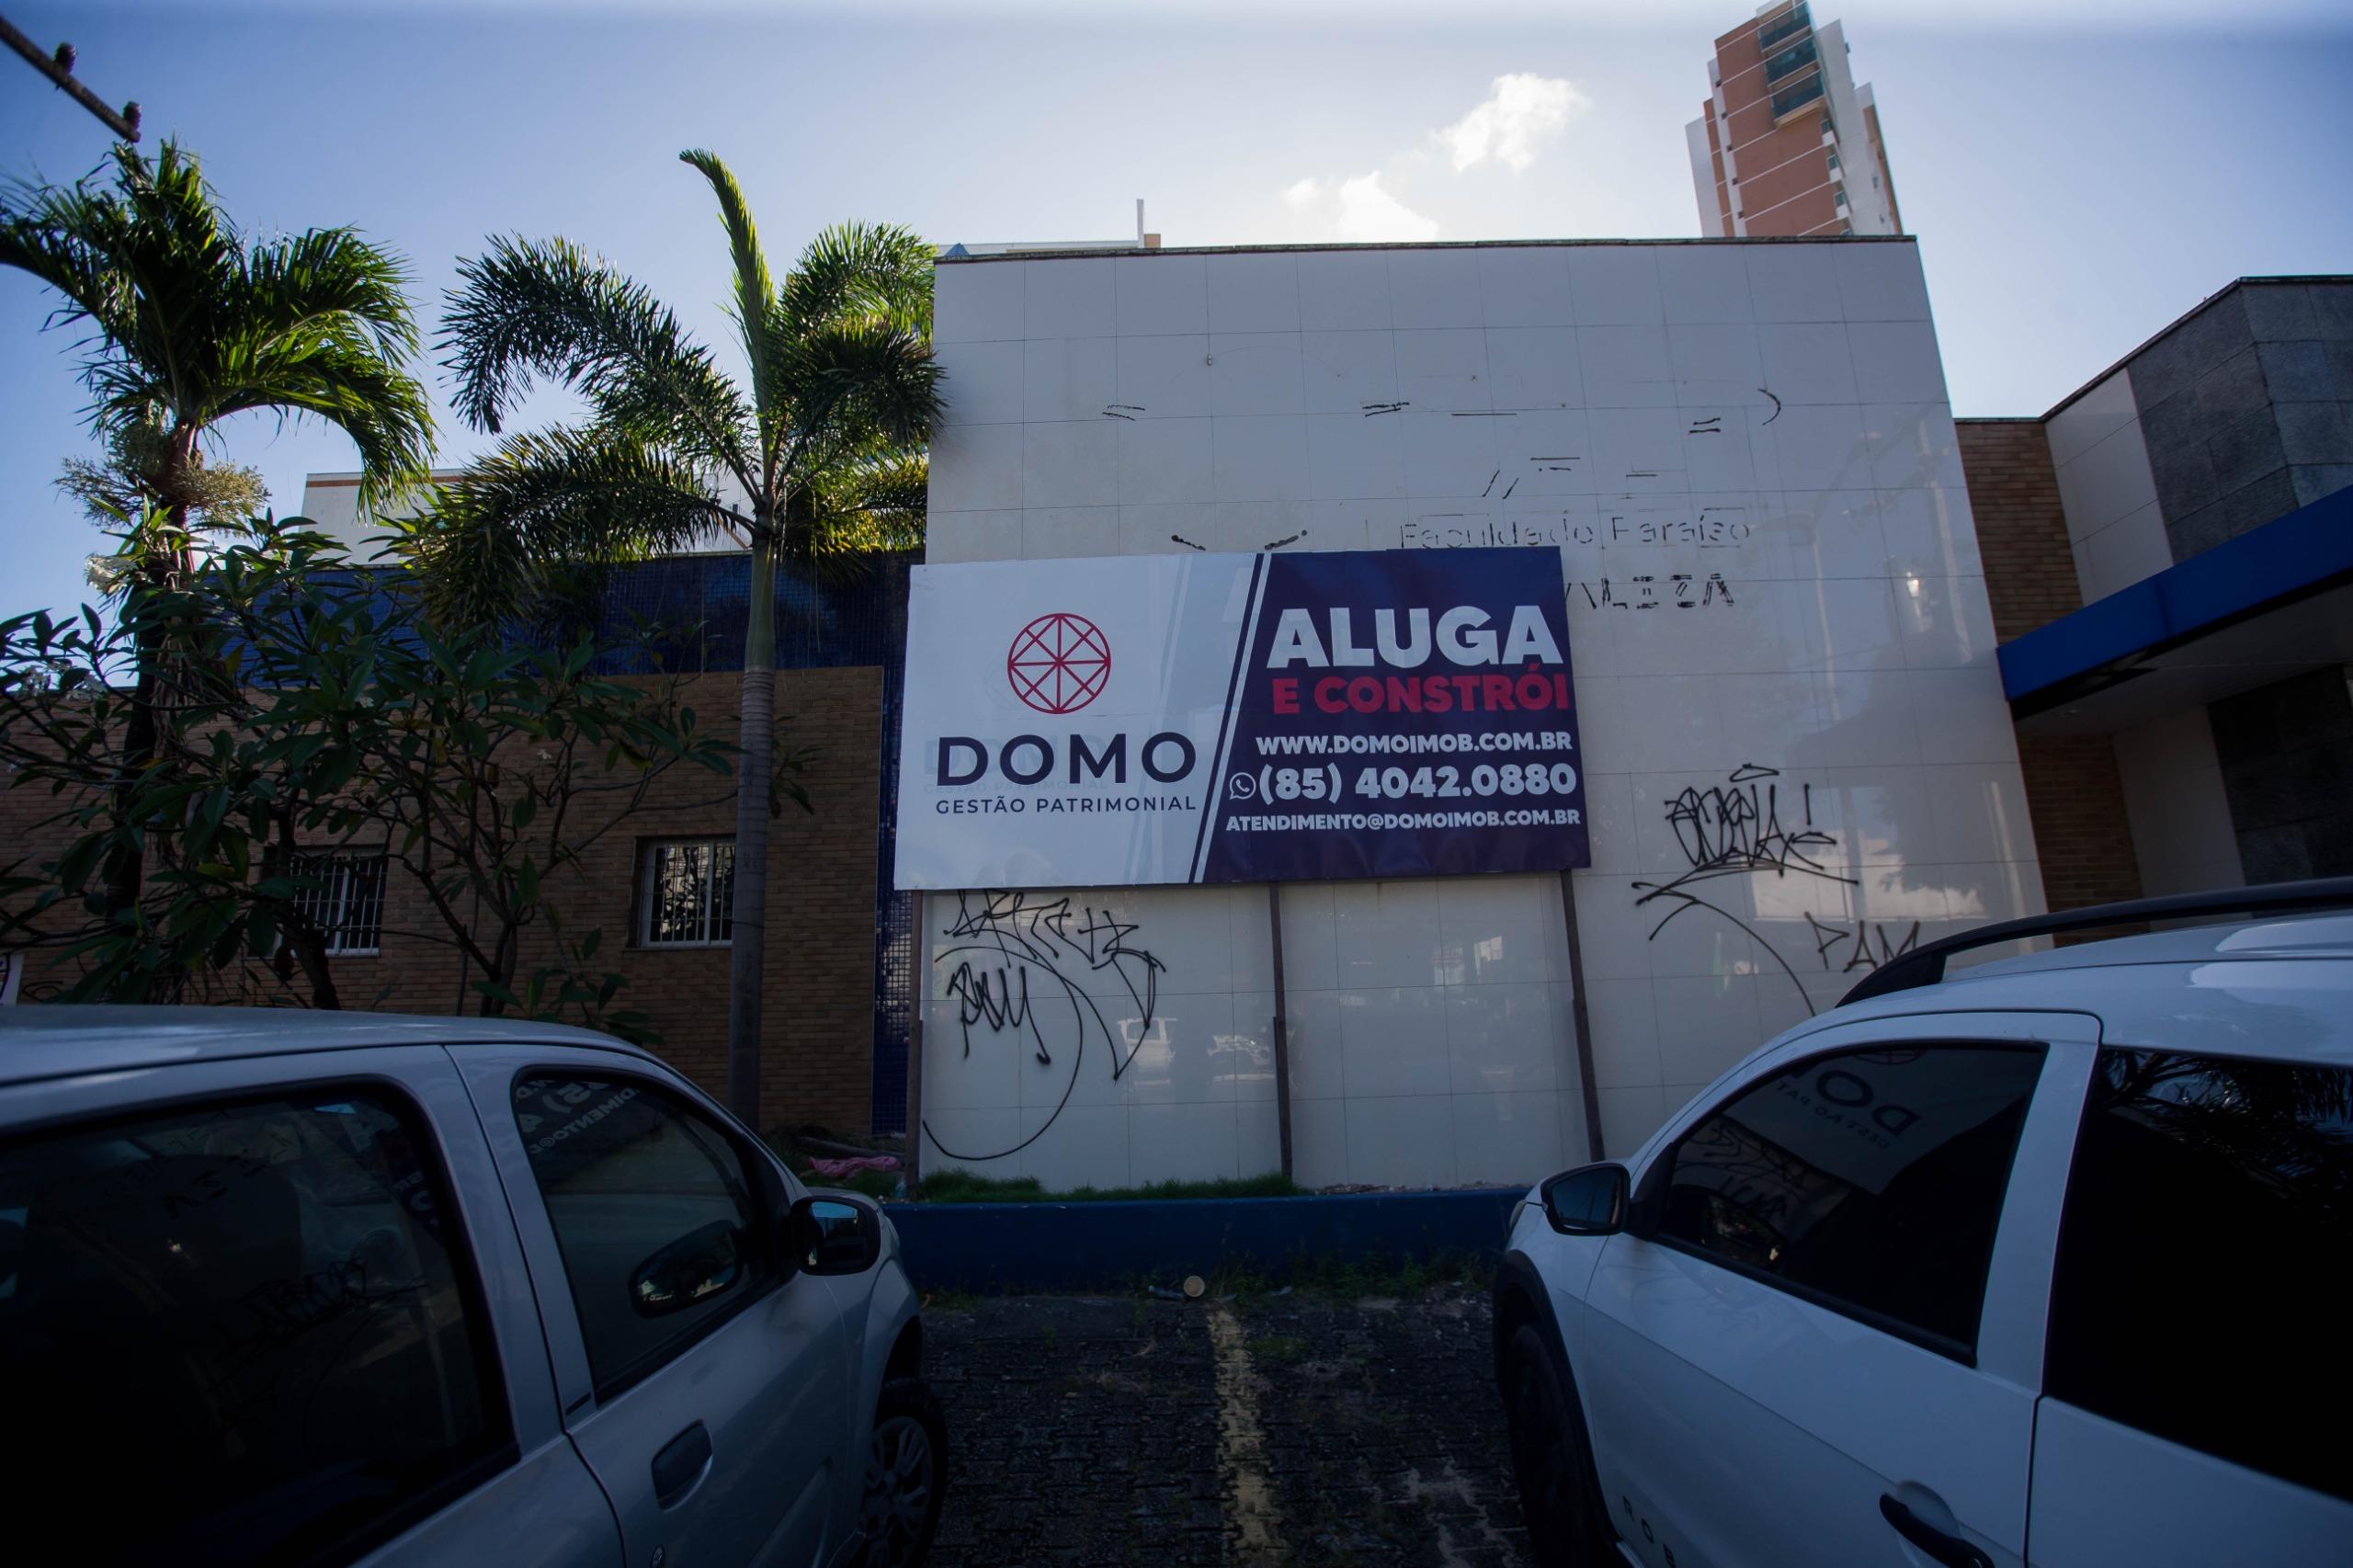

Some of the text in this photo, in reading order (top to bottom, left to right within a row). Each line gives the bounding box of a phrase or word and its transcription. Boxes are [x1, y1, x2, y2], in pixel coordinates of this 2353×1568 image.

[1267, 605, 1564, 669] ALUGA
[1271, 663, 1570, 715] E CONSTRÓI
[937, 732, 1197, 787] DOMO
[1256, 731, 1574, 756] WWW.DOMOIMOB.COM.BR
[936, 795, 1197, 814] GESTÃO PATRIMONIAL
[1258, 762, 1577, 806] (85) 4042.0880
[1225, 809, 1581, 832] ATENDIMENTO@DOMOIMOB.COM.BR
